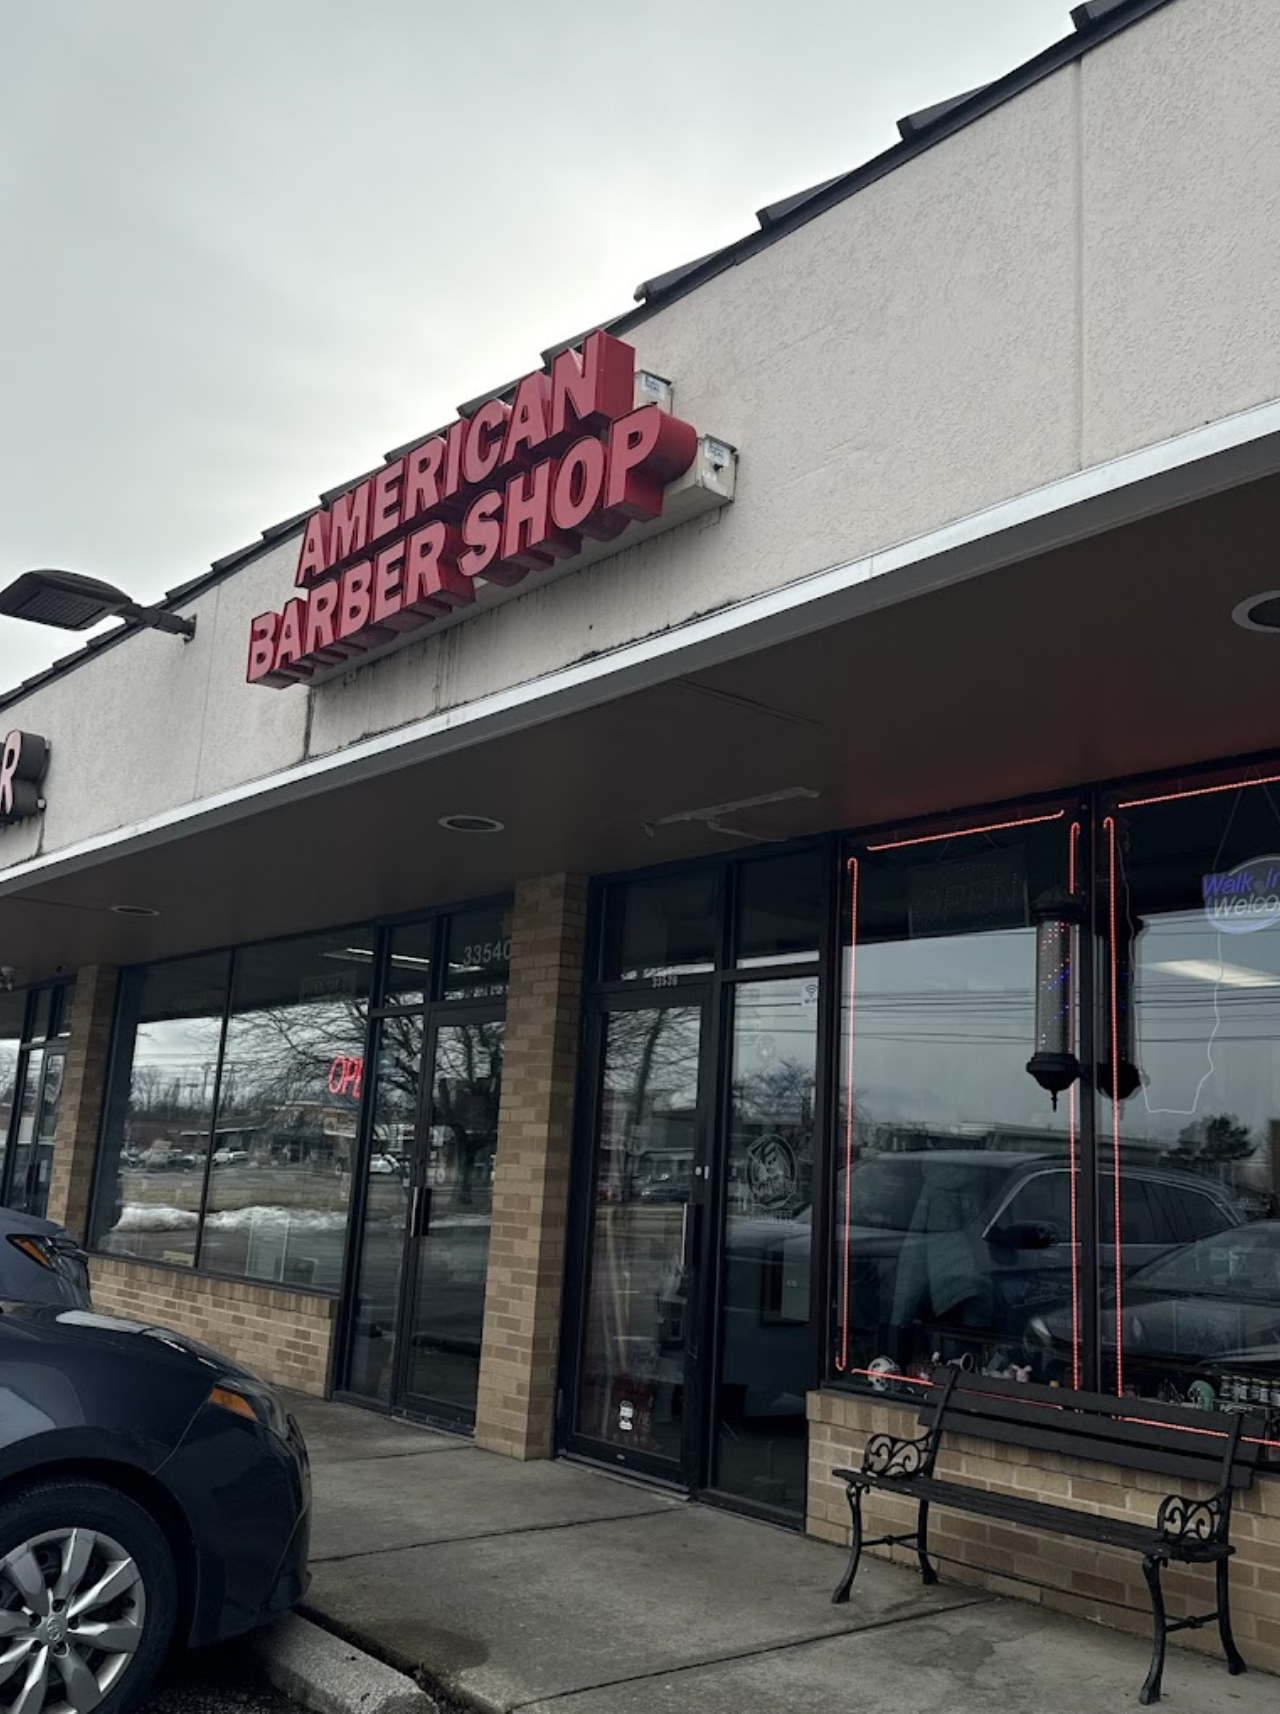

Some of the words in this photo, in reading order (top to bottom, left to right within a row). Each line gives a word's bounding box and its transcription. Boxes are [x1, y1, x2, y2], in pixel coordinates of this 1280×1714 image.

[295, 330, 605, 587] AMERICAN
[247, 521, 447, 684] BARBER
[458, 404, 660, 577] SHOP
[1202, 872, 1254, 898] Walk
[1213, 893, 1280, 918] Welco
[463, 940, 513, 966] 33540
